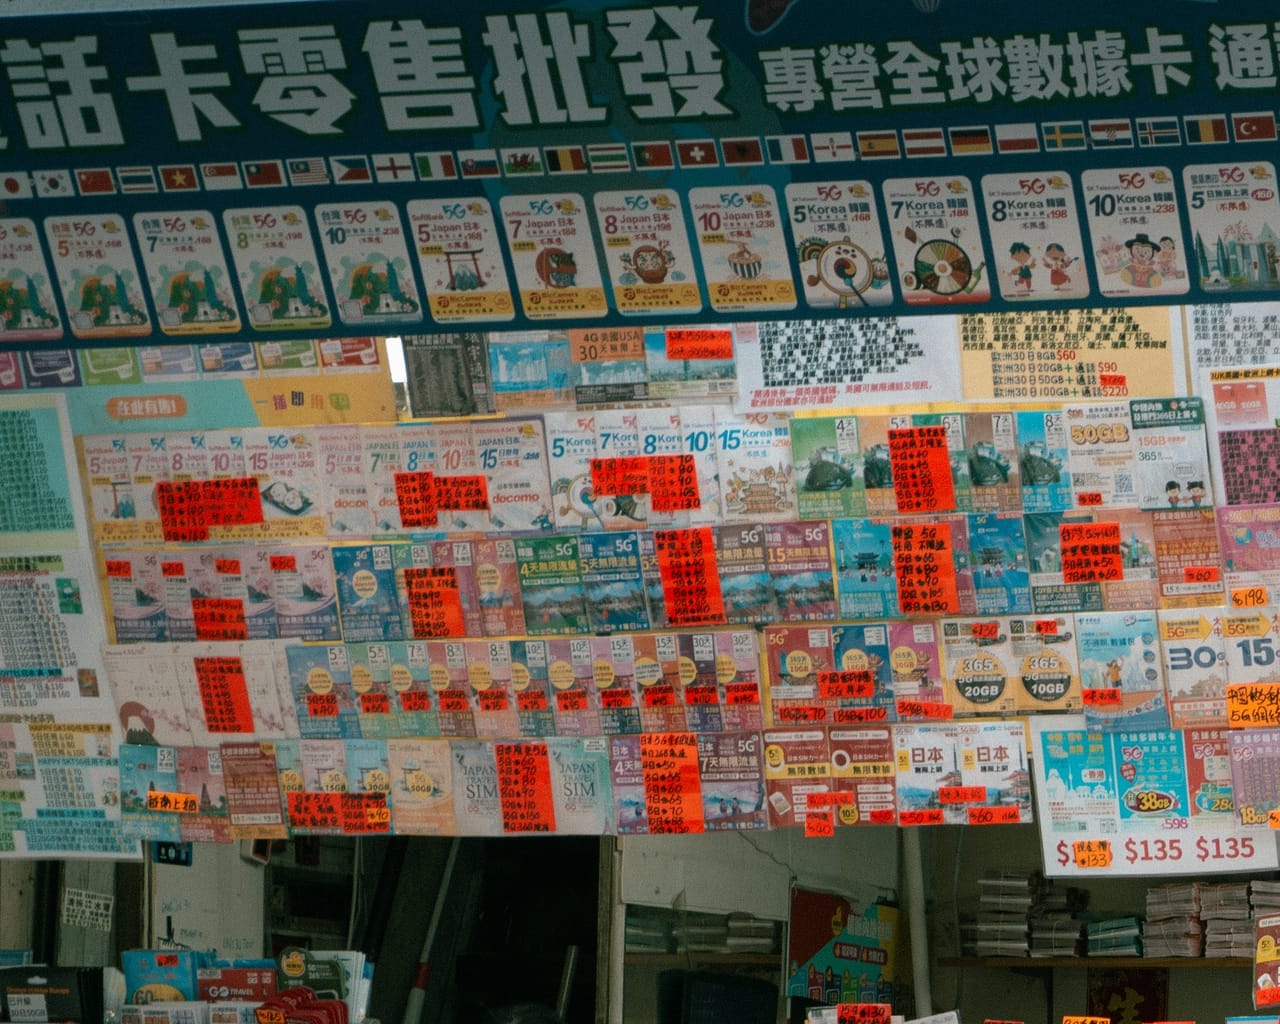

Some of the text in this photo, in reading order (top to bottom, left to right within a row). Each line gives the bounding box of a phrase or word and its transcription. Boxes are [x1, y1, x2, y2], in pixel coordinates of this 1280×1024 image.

[0, 6, 734, 148] 話卡零售批發
[762, 28, 1192, 111] 專營全球數據卡
[1088, 192, 1175, 217] 10 Korea 韓國
[1192, 191, 1205, 209] 5
[698, 210, 773, 231] 10 Japan 日本
[794, 202, 848, 222] 5 Korea
[418, 221, 481, 243] 5 Japan 日本
[579, 346, 598, 361] 30
[717, 427, 772, 449] 15 Korea
[1070, 424, 1129, 445] 50GB
[1137, 436, 1167, 447] 15GB
[492, 492, 540, 503] docomo
[965, 684, 999, 696] 20GB
[1031, 683, 1065, 694] 10GB
[911, 745, 944, 764] 日本
[976, 745, 1010, 763] 日本
[559, 762, 595, 774] JAPAN
[558, 775, 595, 786] TRAVEL
[563, 782, 595, 798] SIM
[1137, 792, 1172, 810] 38GB
[1124, 837, 1256, 861] $135 $135
